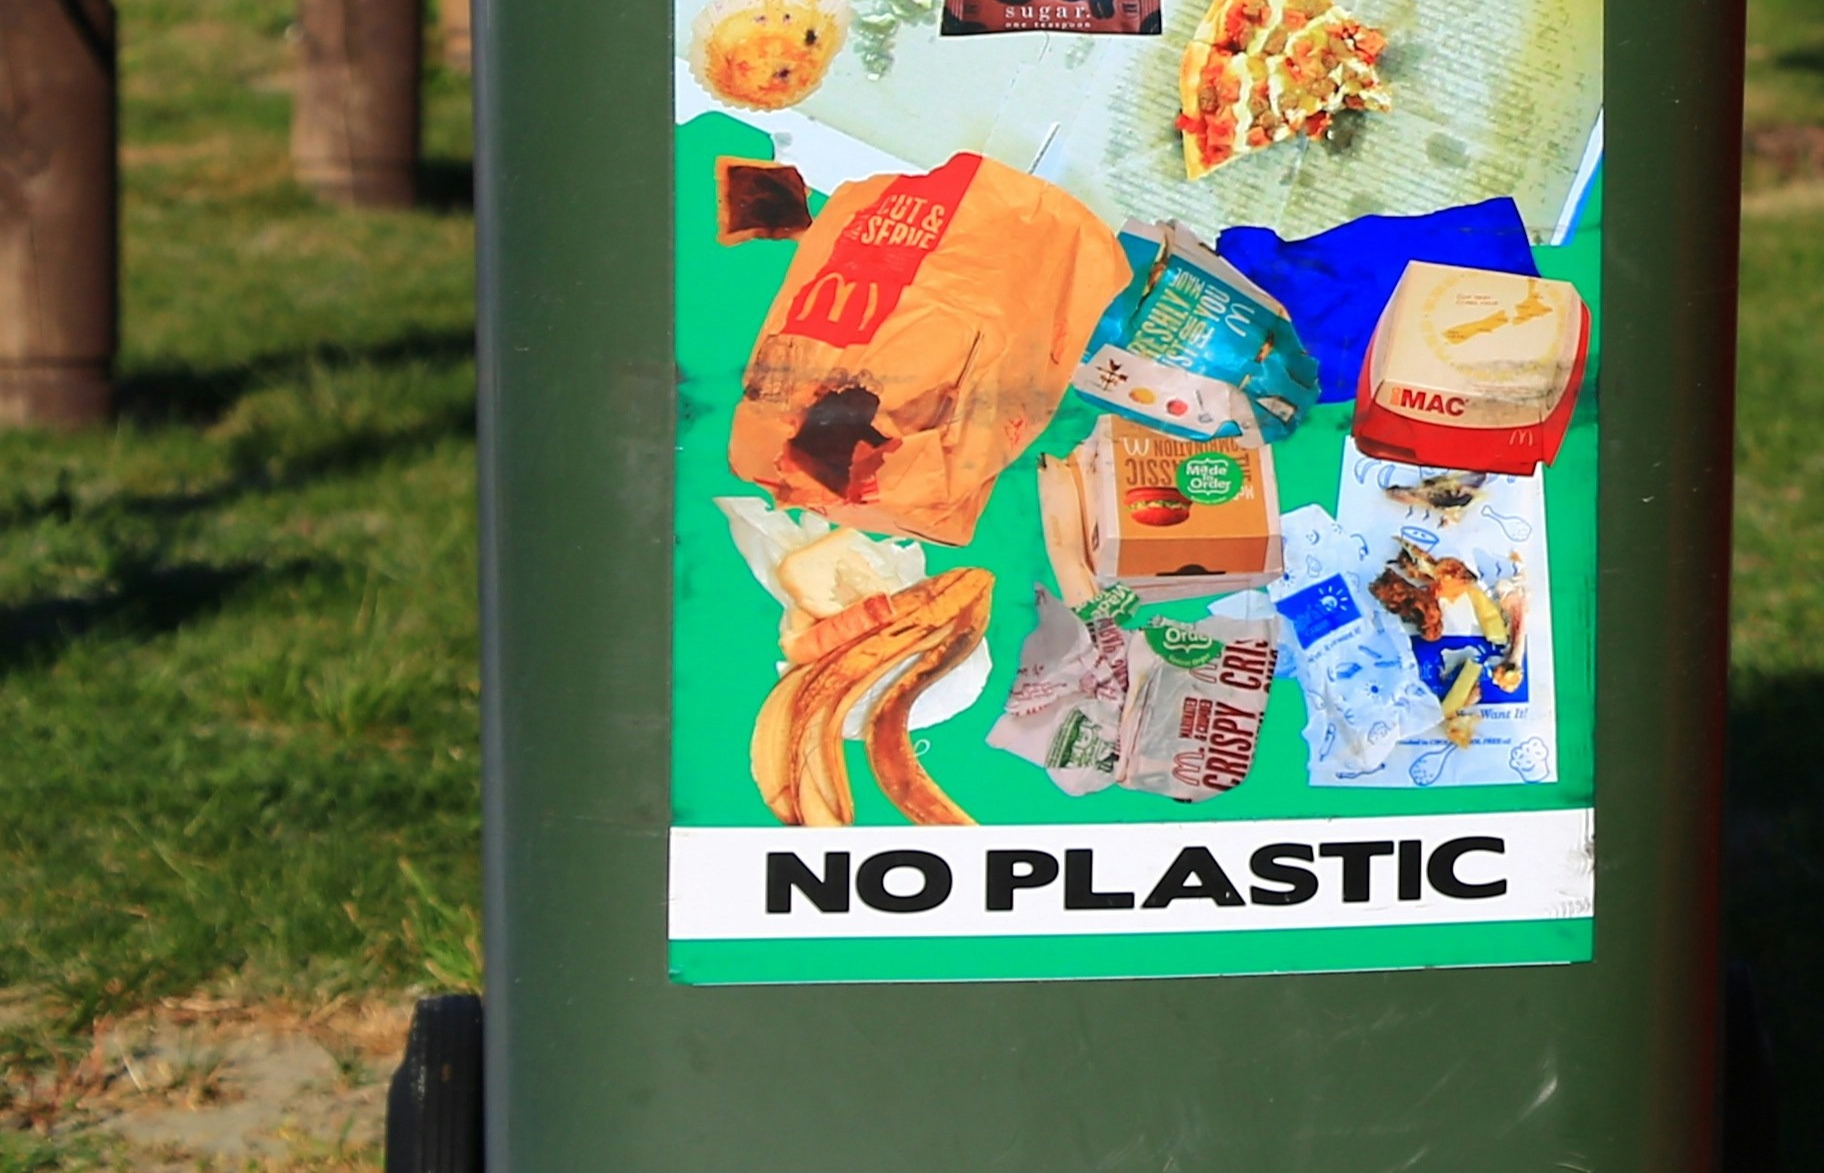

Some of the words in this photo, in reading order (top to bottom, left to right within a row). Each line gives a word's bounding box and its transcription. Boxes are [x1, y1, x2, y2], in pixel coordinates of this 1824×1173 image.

[1005, 3, 1092, 21] sugar.
[1005, 21, 1027, 29] one
[1034, 21, 1092, 30] teaspoon
[876, 194, 929, 224] CUT
[920, 204, 945, 234] &
[1193, 283, 1231, 323] YOU
[1186, 464, 1228, 476] Made
[1190, 477, 1231, 489] Order
[1479, 707, 1513, 720] Want
[1202, 700, 1258, 791] CRISPY
[765, 849, 954, 914] NO
[984, 836, 1508, 912] PLASTIC
